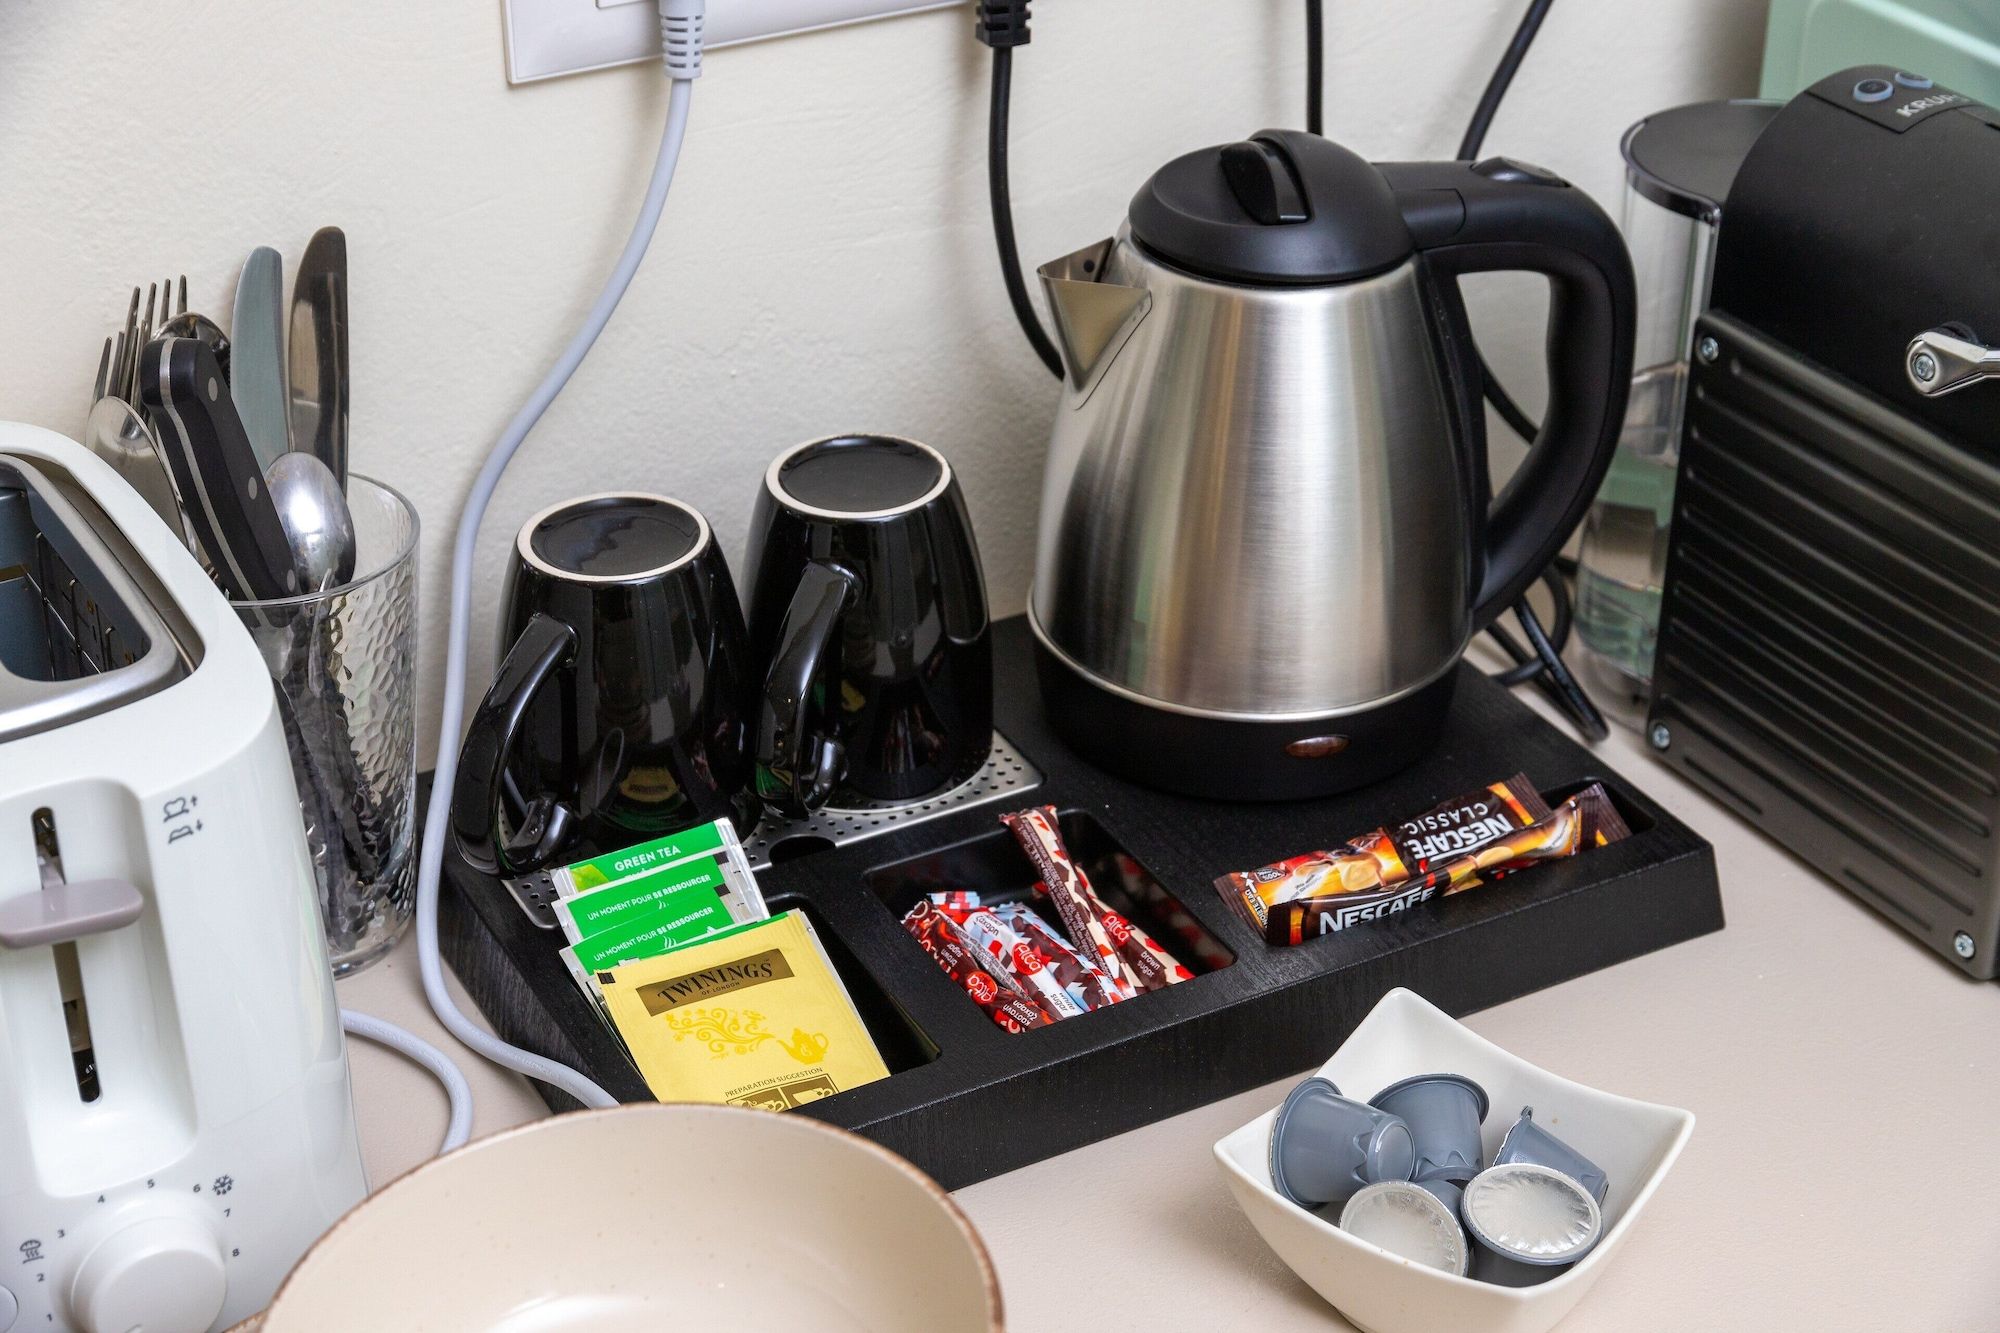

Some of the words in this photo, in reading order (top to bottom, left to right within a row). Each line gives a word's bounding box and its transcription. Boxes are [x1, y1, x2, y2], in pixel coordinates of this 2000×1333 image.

[1896, 94, 1969, 117] KRUP
[1404, 802, 1488, 835] CLASSIC
[614, 851, 656, 872] GREEN
[656, 845, 681, 859] TEA
[587, 911, 600, 921] UN
[600, 901, 632, 917] MOMENT
[631, 894, 653, 906] POUR
[652, 890, 663, 899] SE
[662, 874, 711, 896] RESSOURCER
[594, 952, 607, 962] UN
[606, 939, 638, 956] MOMENT
[637, 931, 658, 943] POUR
[657, 925, 668, 935] SE
[667, 907, 714, 930] RESSOURCER
[941, 950, 958, 967] brown
[946, 943, 964, 957] sugar
[1137, 960, 1155, 978] sugar
[1141, 951, 1160, 970] brown
[657, 962, 773, 1004] TWININGS
[713, 982, 740, 993] LONDON
[1050, 994, 1068, 1012] sugar
[725, 1078, 777, 1098] PREPARATION
[777, 1067, 824, 1083] SUGGESTION
[147, 1179, 155, 1189] 5
[193, 1183, 201, 1193] 6
[97, 1195, 106, 1204] 4
[224, 1208, 232, 1218] 7
[57, 1229, 66, 1239] 3
[232, 1248, 240, 1258] 8
[37, 1273, 45, 1282] 2
[46, 1313, 53, 1323] 1
